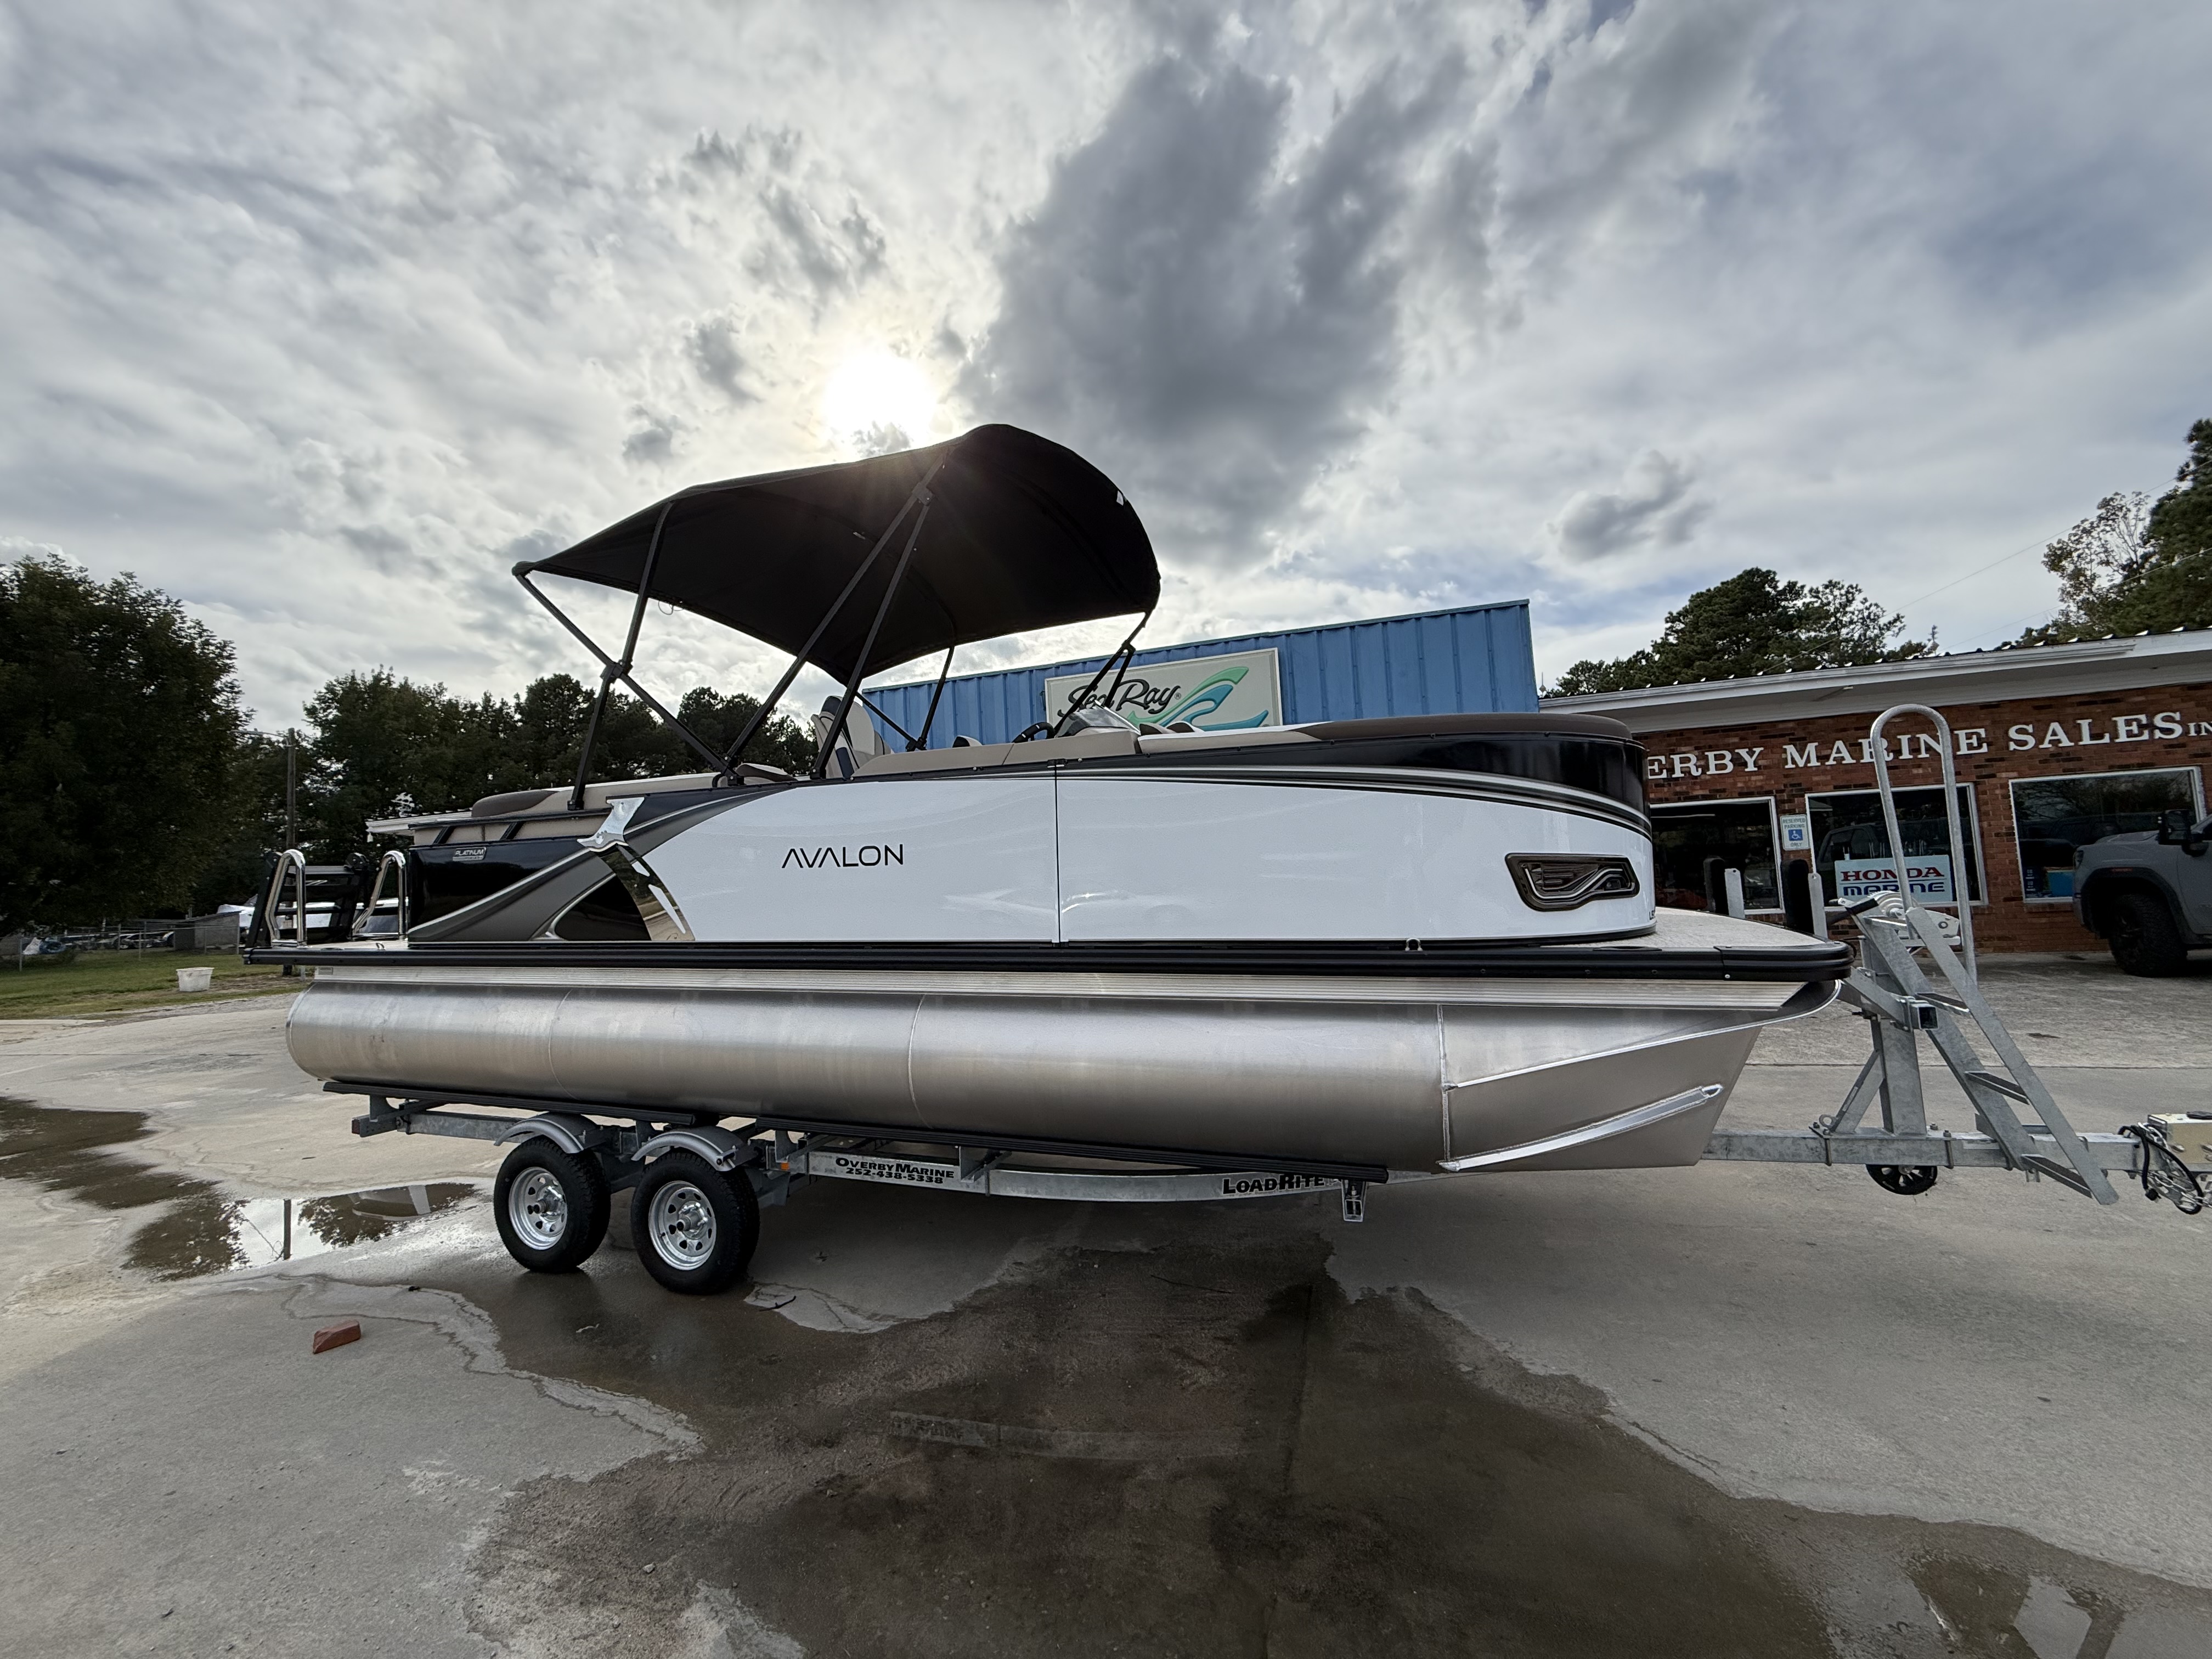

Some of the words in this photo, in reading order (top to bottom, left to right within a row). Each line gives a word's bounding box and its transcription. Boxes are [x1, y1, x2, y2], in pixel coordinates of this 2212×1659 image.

[1647, 747, 1764, 779] ERBY
[1782, 728, 1988, 769] MARINE
[2008, 712, 2183, 751] SALES
[781, 844, 904, 868] AVALON
[1841, 867, 1945, 881] HONDA
[1843, 882, 1945, 896] MARNE
[846, 1167, 944, 1184] 252-438-5338
[1222, 1173, 1325, 1195] LOADRITE
